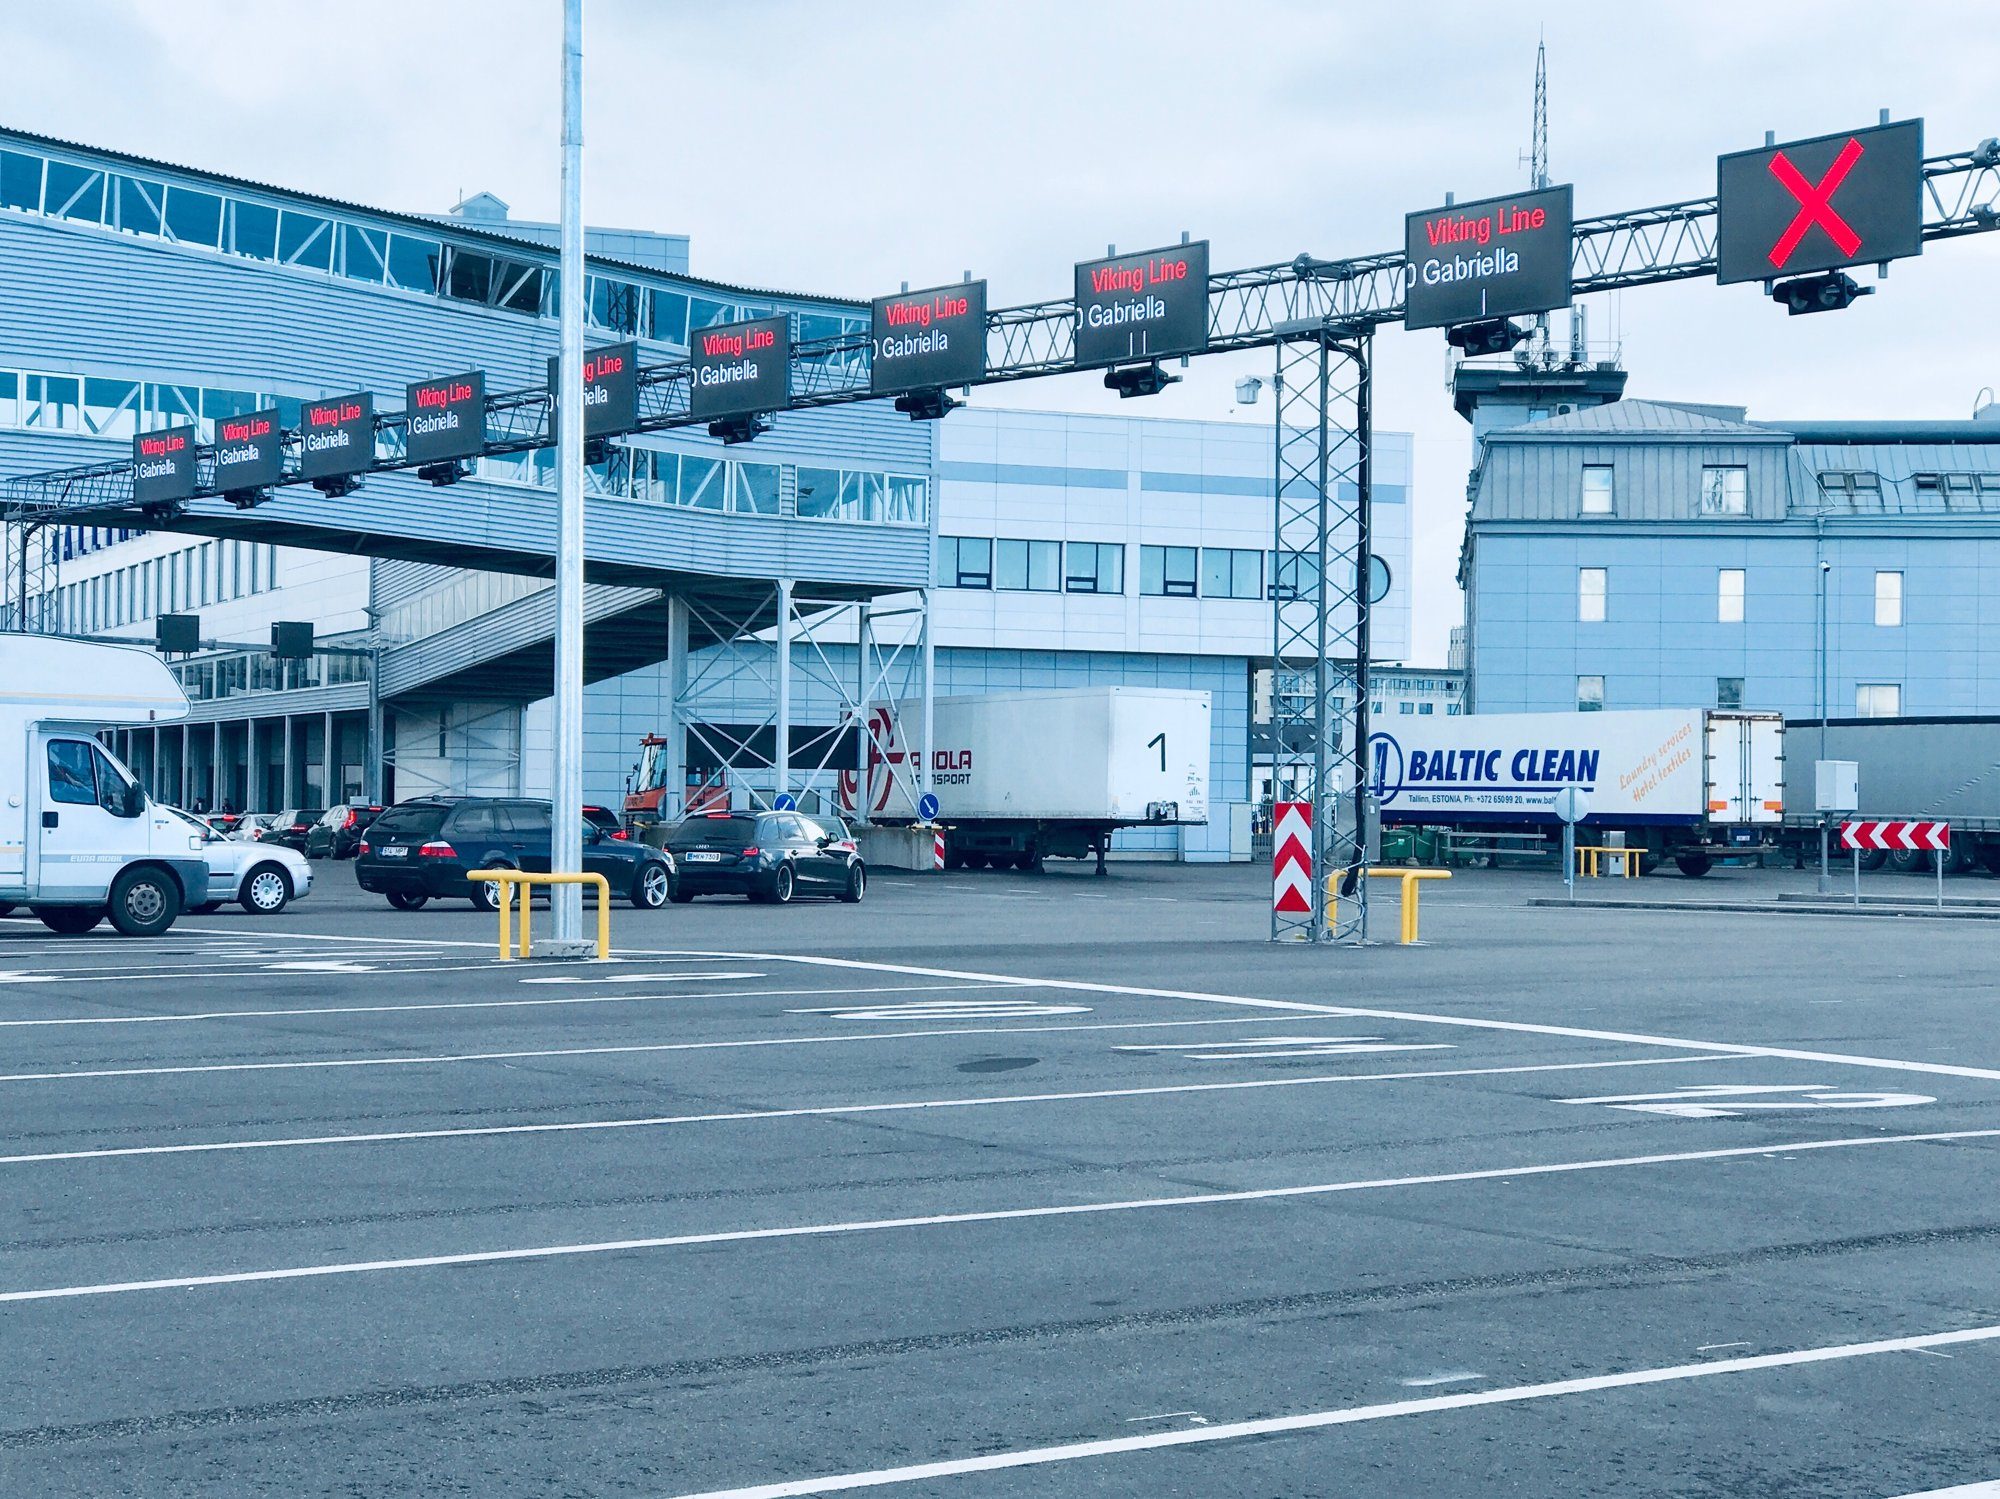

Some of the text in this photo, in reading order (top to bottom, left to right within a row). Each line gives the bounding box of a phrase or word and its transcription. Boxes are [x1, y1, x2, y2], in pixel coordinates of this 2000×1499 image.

[1426, 205, 1545, 246] Viking Line
[1091, 258, 1187, 293] Viking Line
[1423, 247, 1519, 285] Gabriella
[886, 295, 968, 326] Viking Line
[1088, 295, 1165, 328] Gabriella
[703, 328, 774, 356] Viking Line
[882, 329, 948, 358] Gabriella
[597, 355, 622, 375] Line
[700, 359, 758, 386] Gabriella
[416, 383, 472, 408] Viking Line
[310, 403, 361, 427] Viking Line
[413, 410, 459, 434] Gabriella
[222, 418, 270, 441] Viking Line
[307, 429, 350, 451] Gabriella
[140, 434, 185, 456] Viking Line
[220, 444, 259, 465] Gabriella
[139, 458, 176, 479] Gabriella
[910, 750, 972, 770] AOLA
[1147, 732, 1167, 772] 1
[1408, 749, 1600, 782] BALTIC CLEAN
[1619, 723, 1692, 790] Laundry services
[1632, 748, 1691, 802] Hotel textiles
[1408, 794, 1431, 804] Tallinn,
[1476, 795, 1492, 804] +372
